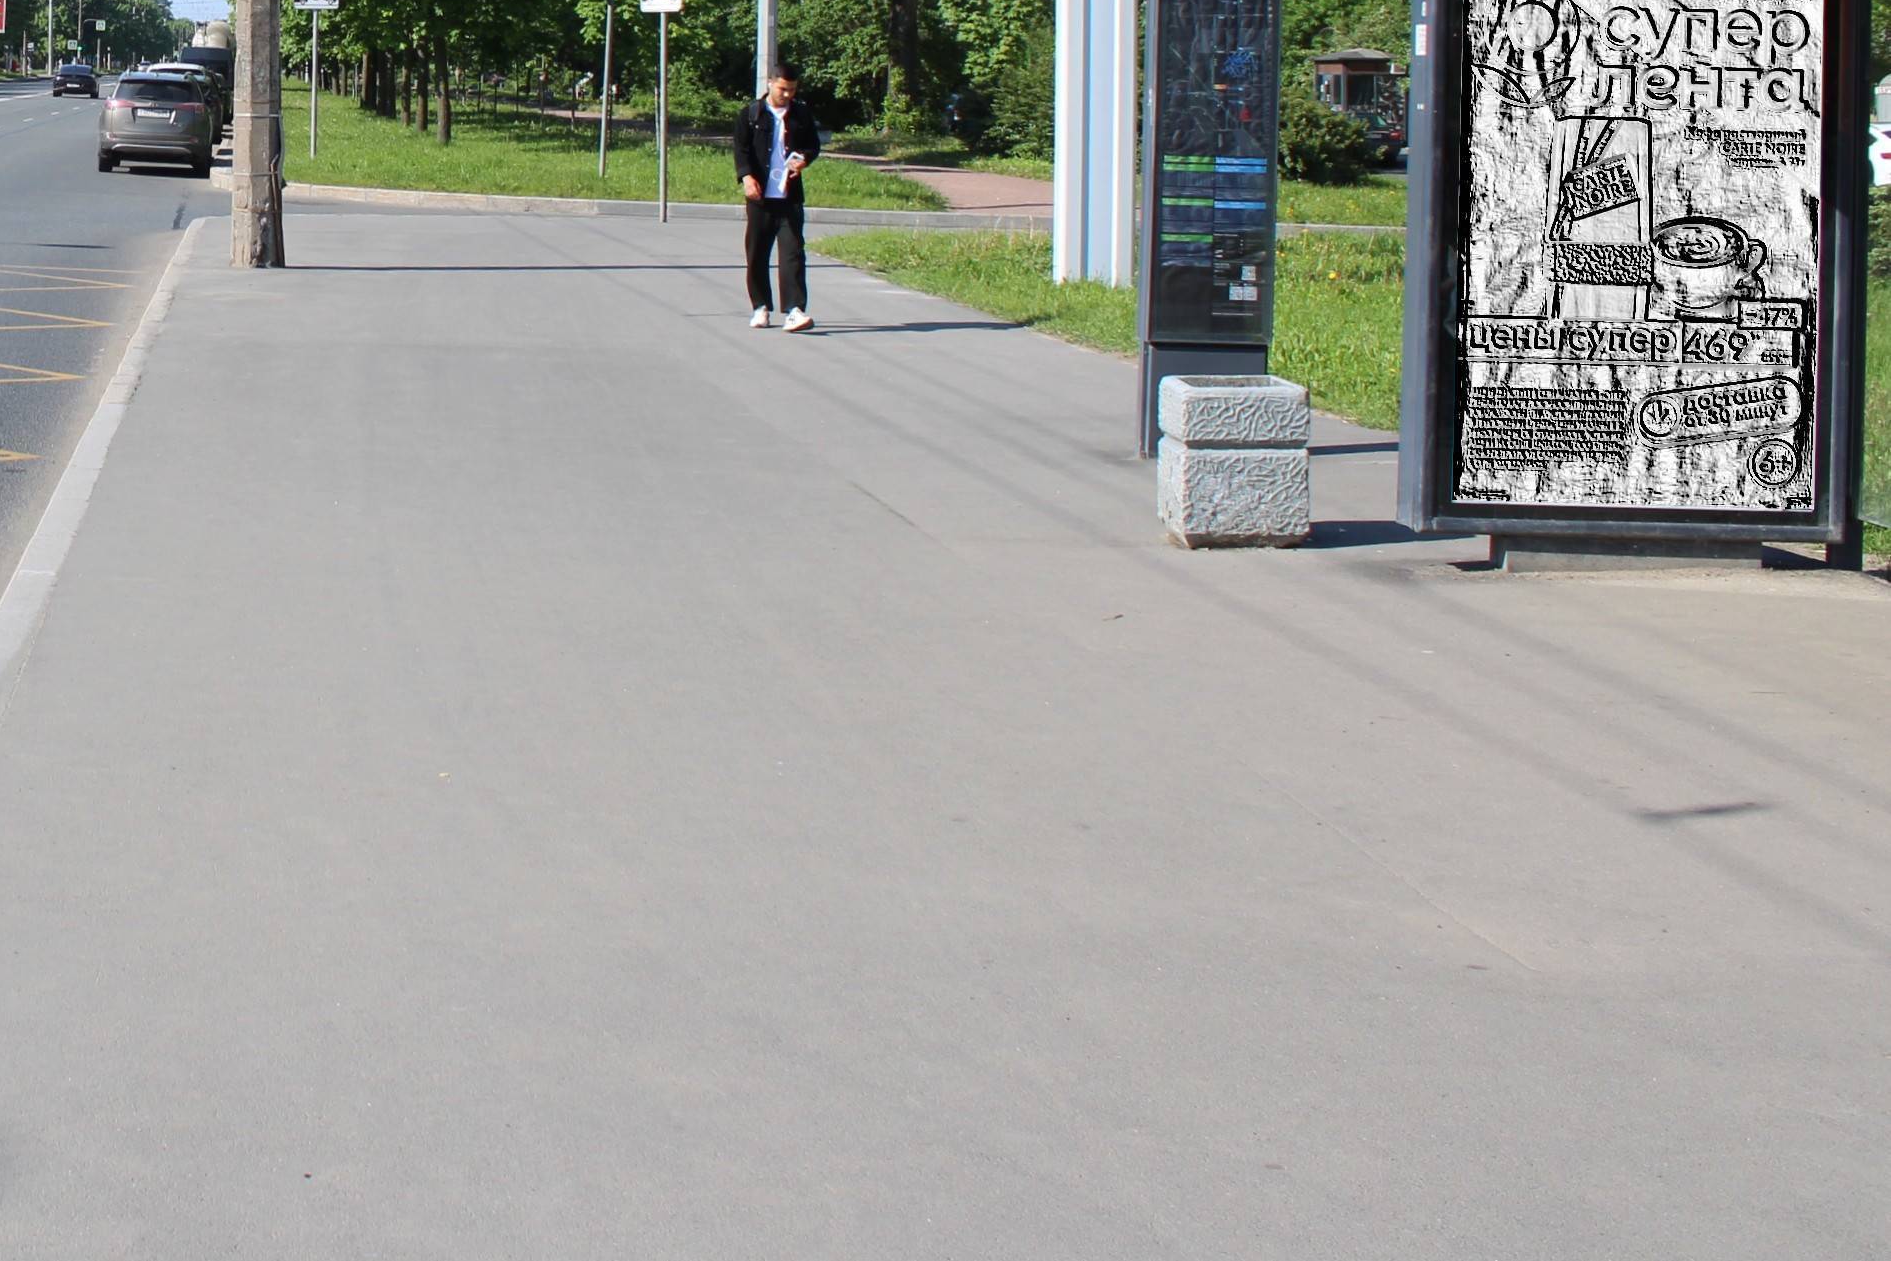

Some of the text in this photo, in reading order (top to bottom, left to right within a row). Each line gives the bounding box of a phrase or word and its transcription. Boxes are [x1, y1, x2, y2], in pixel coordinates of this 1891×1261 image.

[1601, 5, 1811, 65] супер
[1591, 64, 1807, 111] лента
[1721, 142, 1806, 155] CARTE NOIRE
[1572, 163, 1629, 194] CARTE
[1568, 179, 1636, 212] NOIRE
[1469, 324, 1557, 353] цены
[1567, 326, 1678, 362] супер
[1683, 385, 1789, 415] доставка
[1735, 403, 1788, 421] минут
